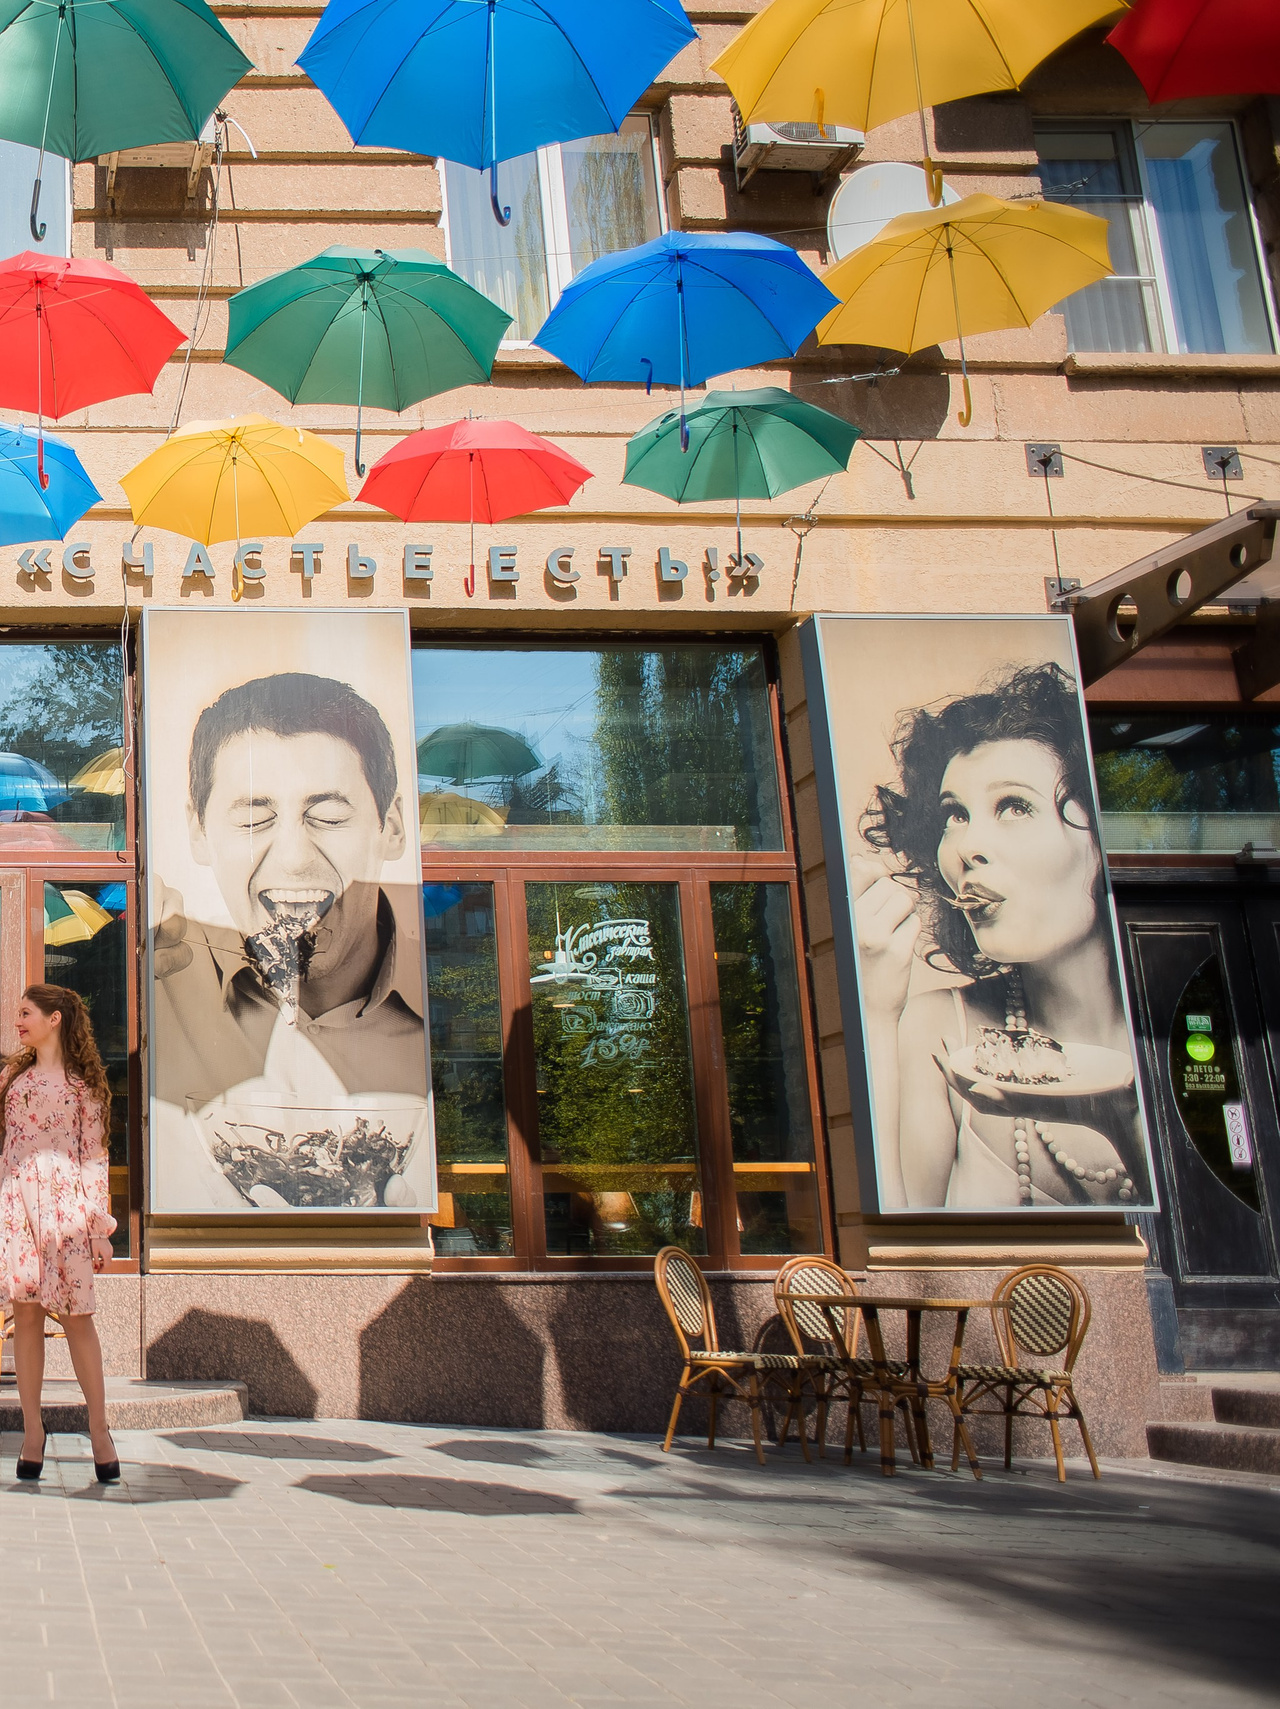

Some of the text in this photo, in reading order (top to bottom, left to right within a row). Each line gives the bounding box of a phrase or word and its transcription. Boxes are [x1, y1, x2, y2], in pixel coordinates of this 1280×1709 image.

[605, 938, 656, 962] завтрак
[624, 973, 656, 983] каша
[1183, 1073, 1199, 1082] 7:30
